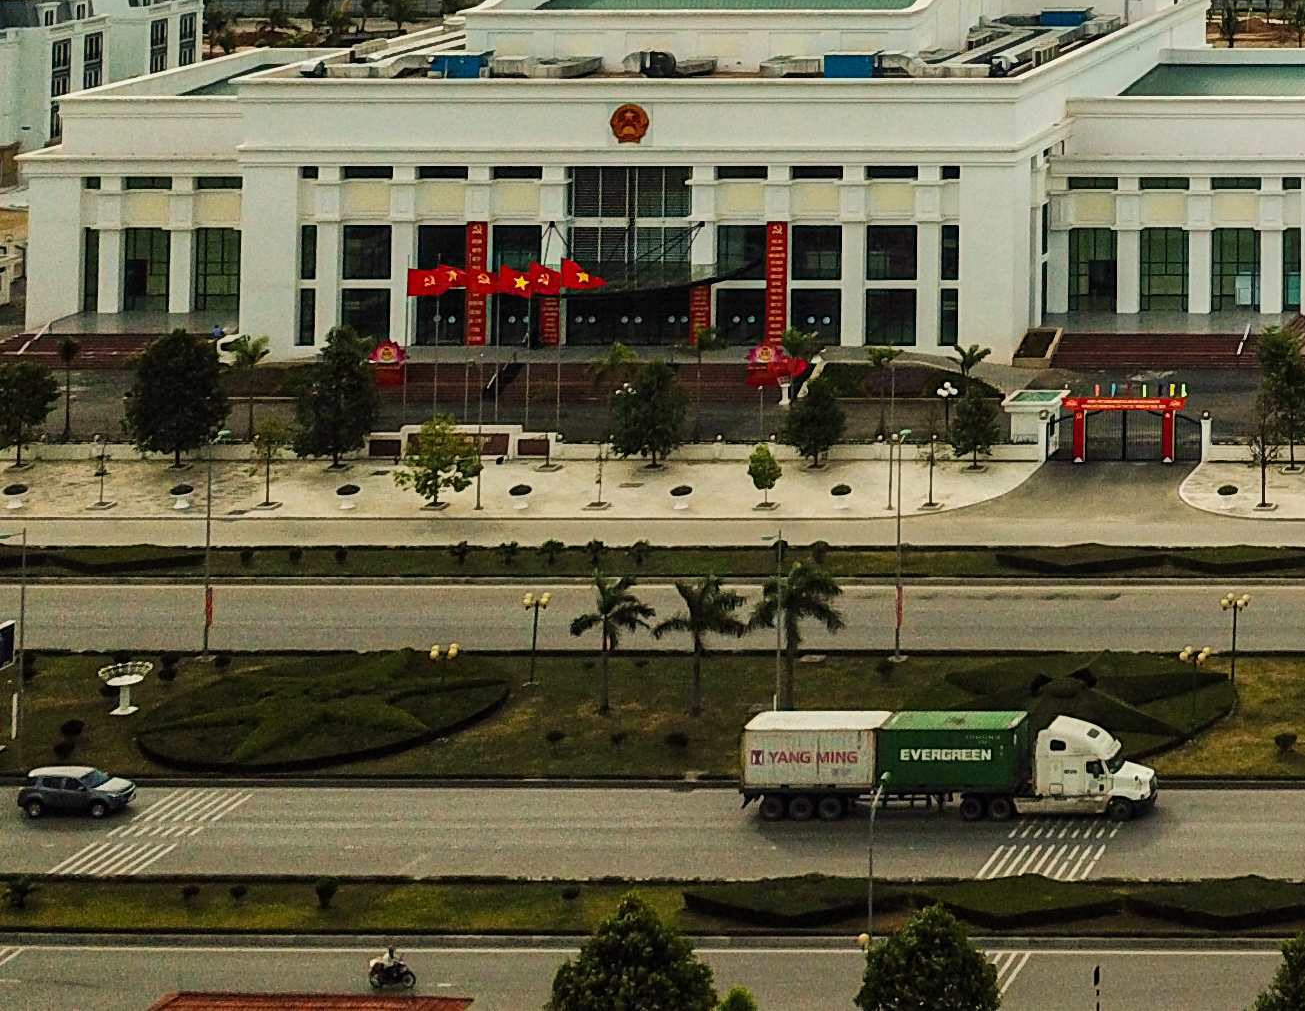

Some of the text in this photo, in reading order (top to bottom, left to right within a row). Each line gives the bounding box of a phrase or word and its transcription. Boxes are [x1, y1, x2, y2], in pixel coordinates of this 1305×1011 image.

[768, 751, 859, 764] YANG MING
[899, 748, 992, 761] EVERGREEN
